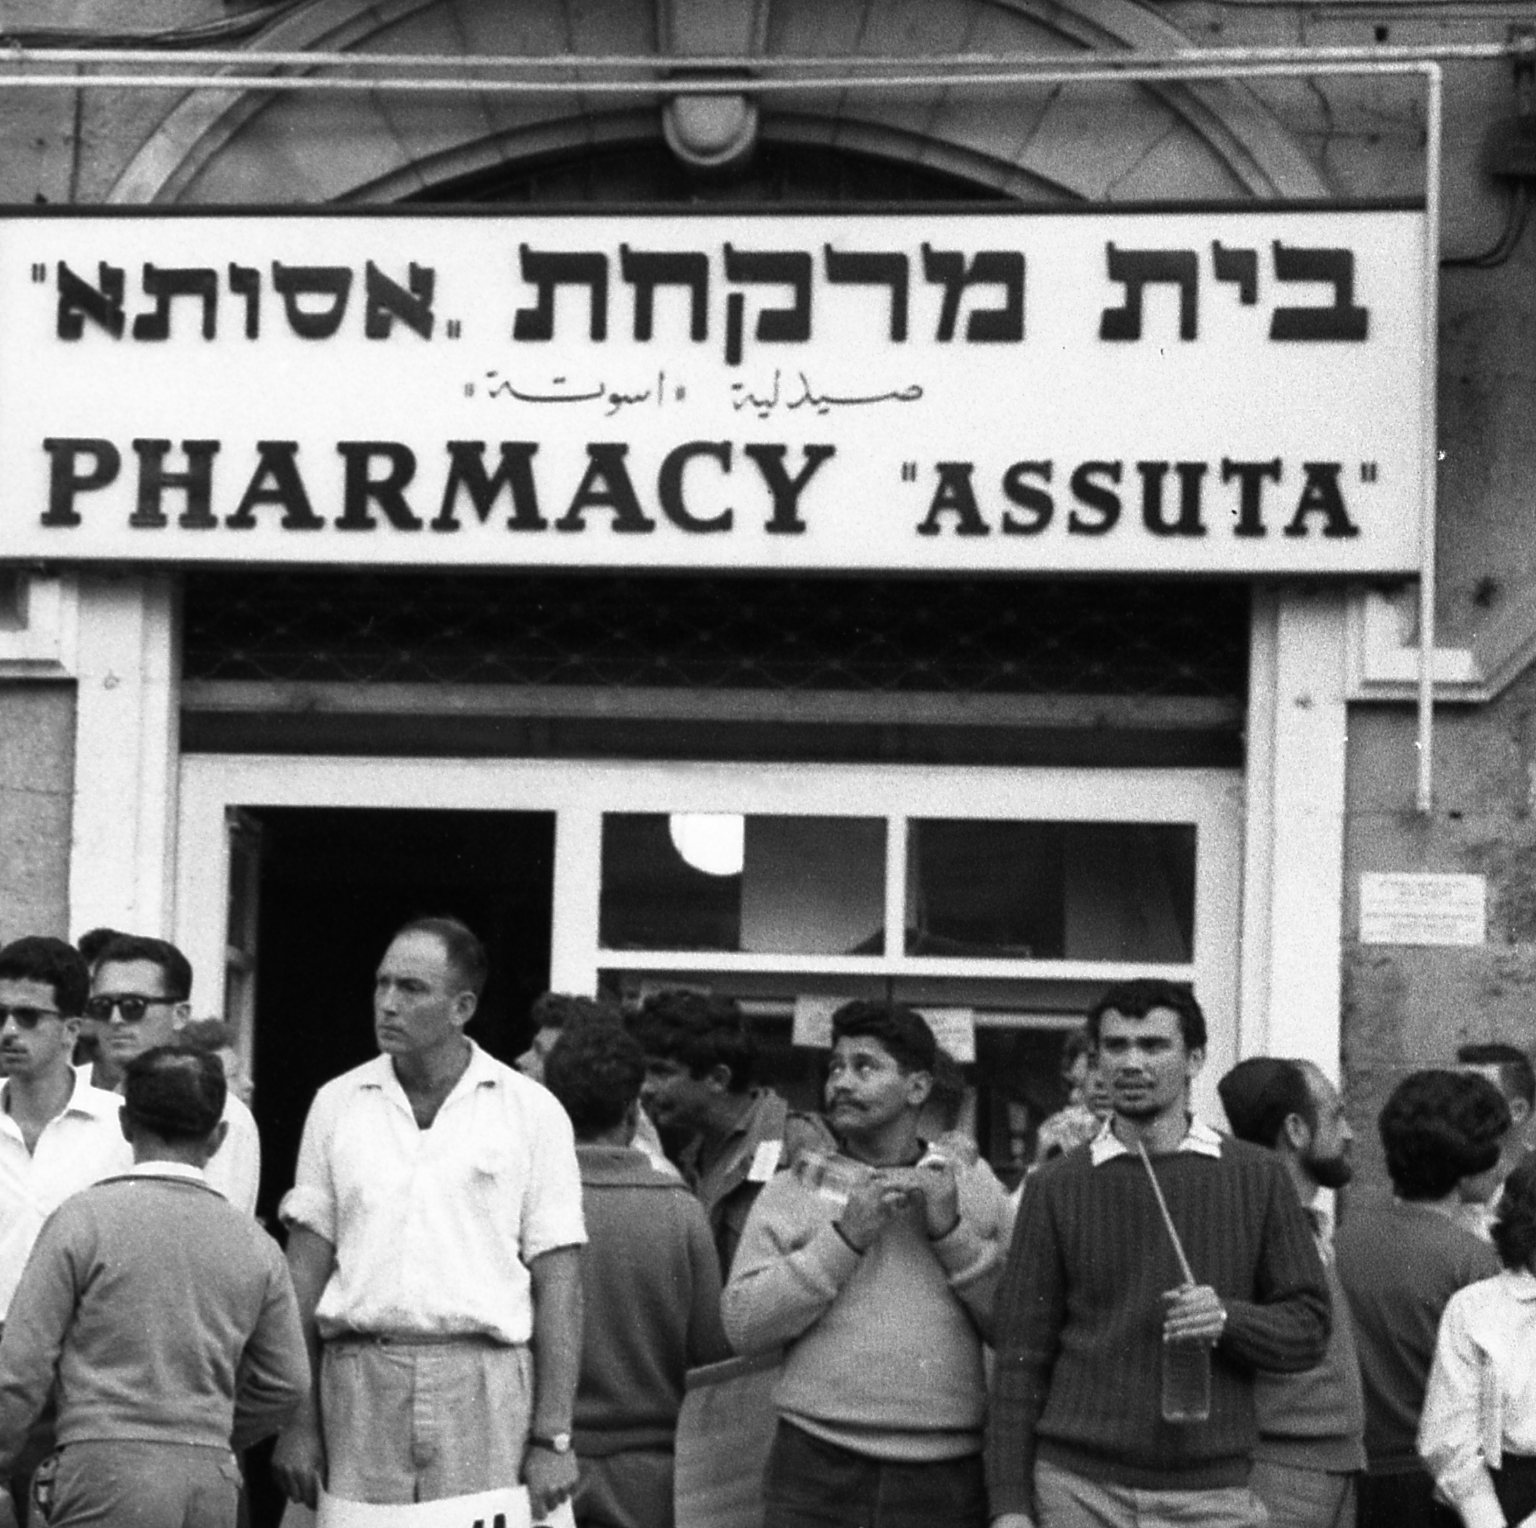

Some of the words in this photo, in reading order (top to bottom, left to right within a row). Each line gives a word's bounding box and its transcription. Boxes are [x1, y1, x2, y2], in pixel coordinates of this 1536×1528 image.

[513, 243, 1026, 365] מרקחת
[1099, 239, 1370, 343] בית
[732, 369, 924, 418] صيدلية
[41, 438, 837, 533] PHARMACY
[902, 457, 1378, 537] "ASSUTA"
